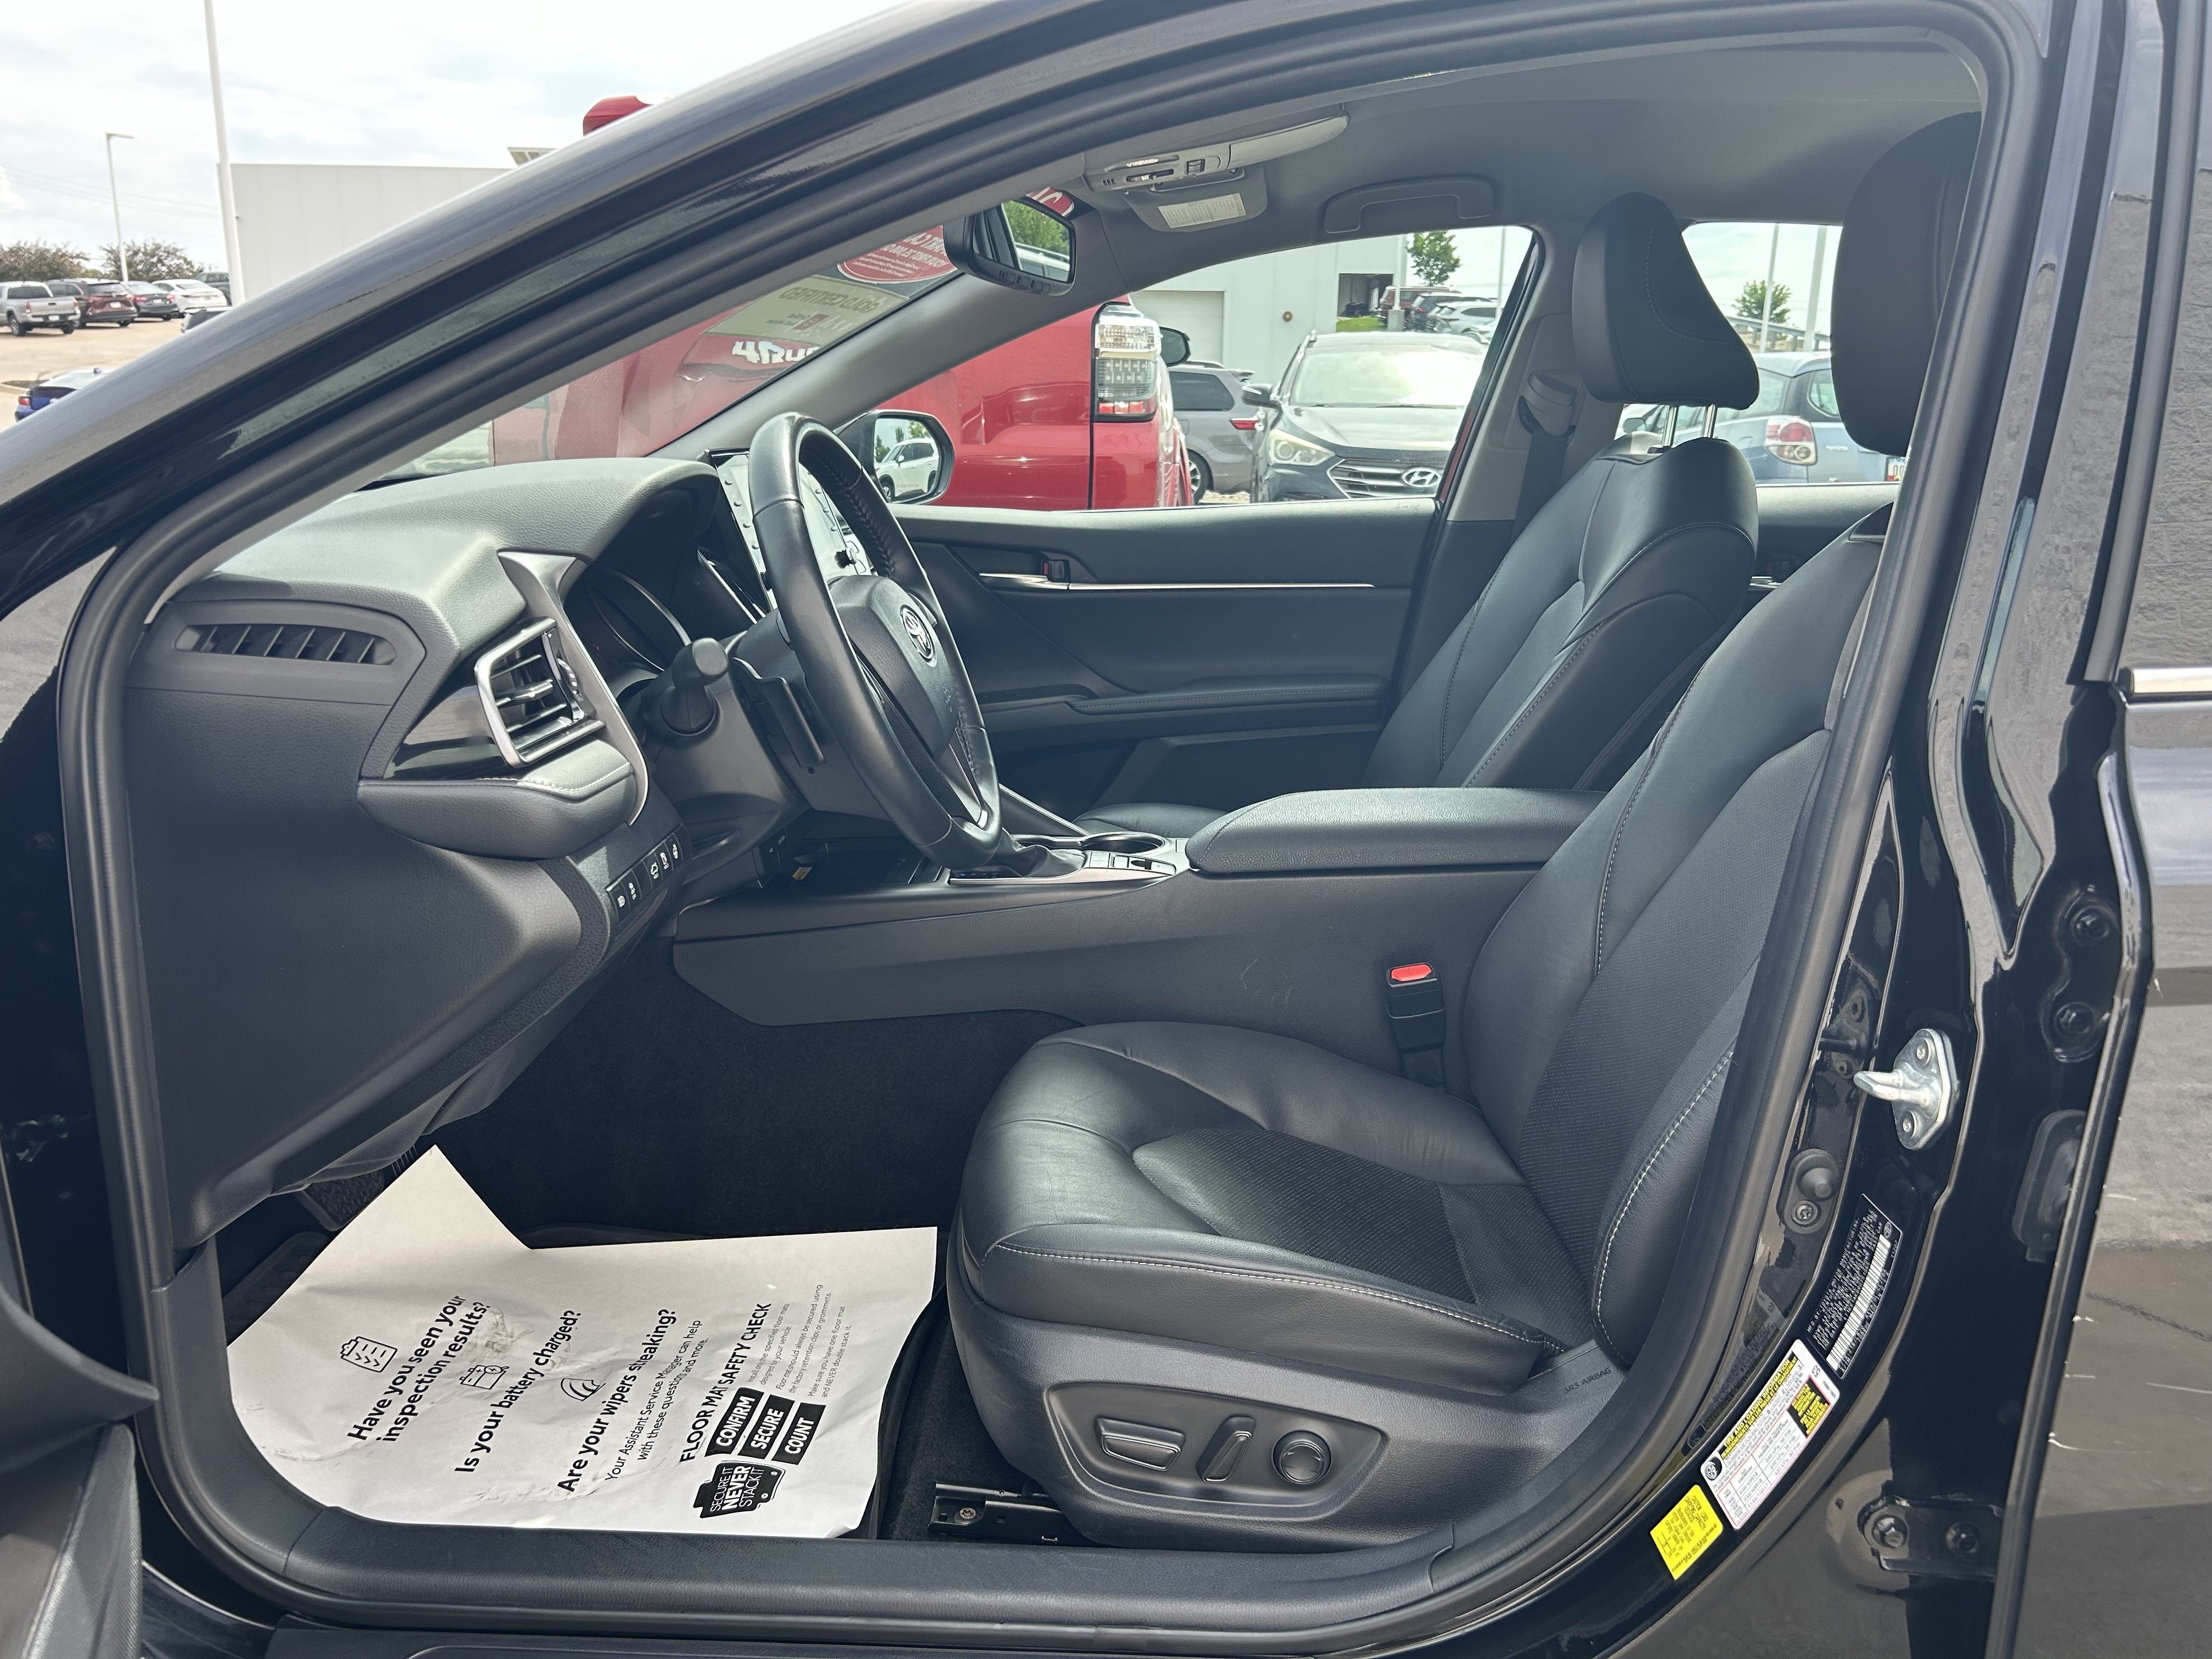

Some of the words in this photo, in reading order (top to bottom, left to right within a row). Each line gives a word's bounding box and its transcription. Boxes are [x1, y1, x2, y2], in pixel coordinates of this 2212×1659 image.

[838, 1306, 846, 1317] mat
[682, 1321, 703, 1342] help
[775, 1377, 787, 1390] Floor
[787, 1350, 800, 1370] should
[795, 1332, 808, 1349] always
[813, 1284, 823, 1302] using
[810, 1330, 820, 1342] clips
[831, 1318, 842, 1333] floor
[679, 1341, 691, 1353] can
[775, 1345, 783, 1360] your
[822, 1346, 834, 1359] have
[829, 1334, 838, 1345] one
[840, 1332, 850, 1347] stack
[347, 1399, 392, 1441] Have
[385, 1359, 416, 1395] you
[408, 1327, 444, 1363] seen
[435, 1295, 466, 1327] your
[801, 1342, 815, 1368] retention
[820, 1359, 828, 1370] you
[832, 1348, 845, 1367] double
[376, 1360, 451, 1442] inspection
[444, 1302, 491, 1358] results?
[655, 1355, 683, 1384] Manager
[791, 1368, 807, 1385] factory
[815, 1370, 825, 1383] sure
[825, 1367, 838, 1386] NEVER
[1564, 1382, 1579, 1393] SRS
[1581, 1367, 1611, 1385] AIRBAG
[454, 1451, 479, 1472] Is
[470, 1410, 505, 1453] your
[489, 1367, 545, 1409] battery
[532, 1310, 582, 1366] charged?
[640, 1376, 663, 1415] Service
[679, 1404, 715, 1463] FLOOR
[701, 1382, 729, 1407] MAT
[718, 1342, 751, 1385] SAFETY
[740, 1304, 772, 1341] CHECK
[788, 1385, 798, 1393] the
[807, 1383, 820, 1397] Make
[821, 1387, 831, 1398] and
[637, 1436, 655, 1460] with
[647, 1412, 667, 1438] these
[661, 1373, 687, 1409] questions
[682, 1359, 696, 1373] and
[691, 1338, 709, 1358] more.
[1720, 1421, 1749, 1460] RENSEIGNEMENTS
[1747, 1414, 1756, 1426] SUR
[1753, 1406, 1762, 1417] LES
[1759, 1393, 1771, 1410] PNEUS
[1776, 1356, 1798, 1386] CHARGEMENT
[1723, 1432, 1735, 1448] TIRE
[1733, 1420, 1745, 1436] AND
[1743, 1396, 1763, 1424] LOADING
[1760, 1358, 1791, 1399] INFORMATION
[557, 1459, 588, 1492] Are
[578, 1418, 610, 1455] your
[600, 1375, 637, 1415] wipers
[618, 1412, 649, 1455] Assistant
[716, 1395, 755, 1446] CONFIRM
[751, 1408, 784, 1449] SECURE
[785, 1417, 815, 1454] COUNT
[604, 1456, 627, 1481] Your
[710, 1475, 731, 1511] SECURE
[721, 1466, 752, 1510] NEVER
